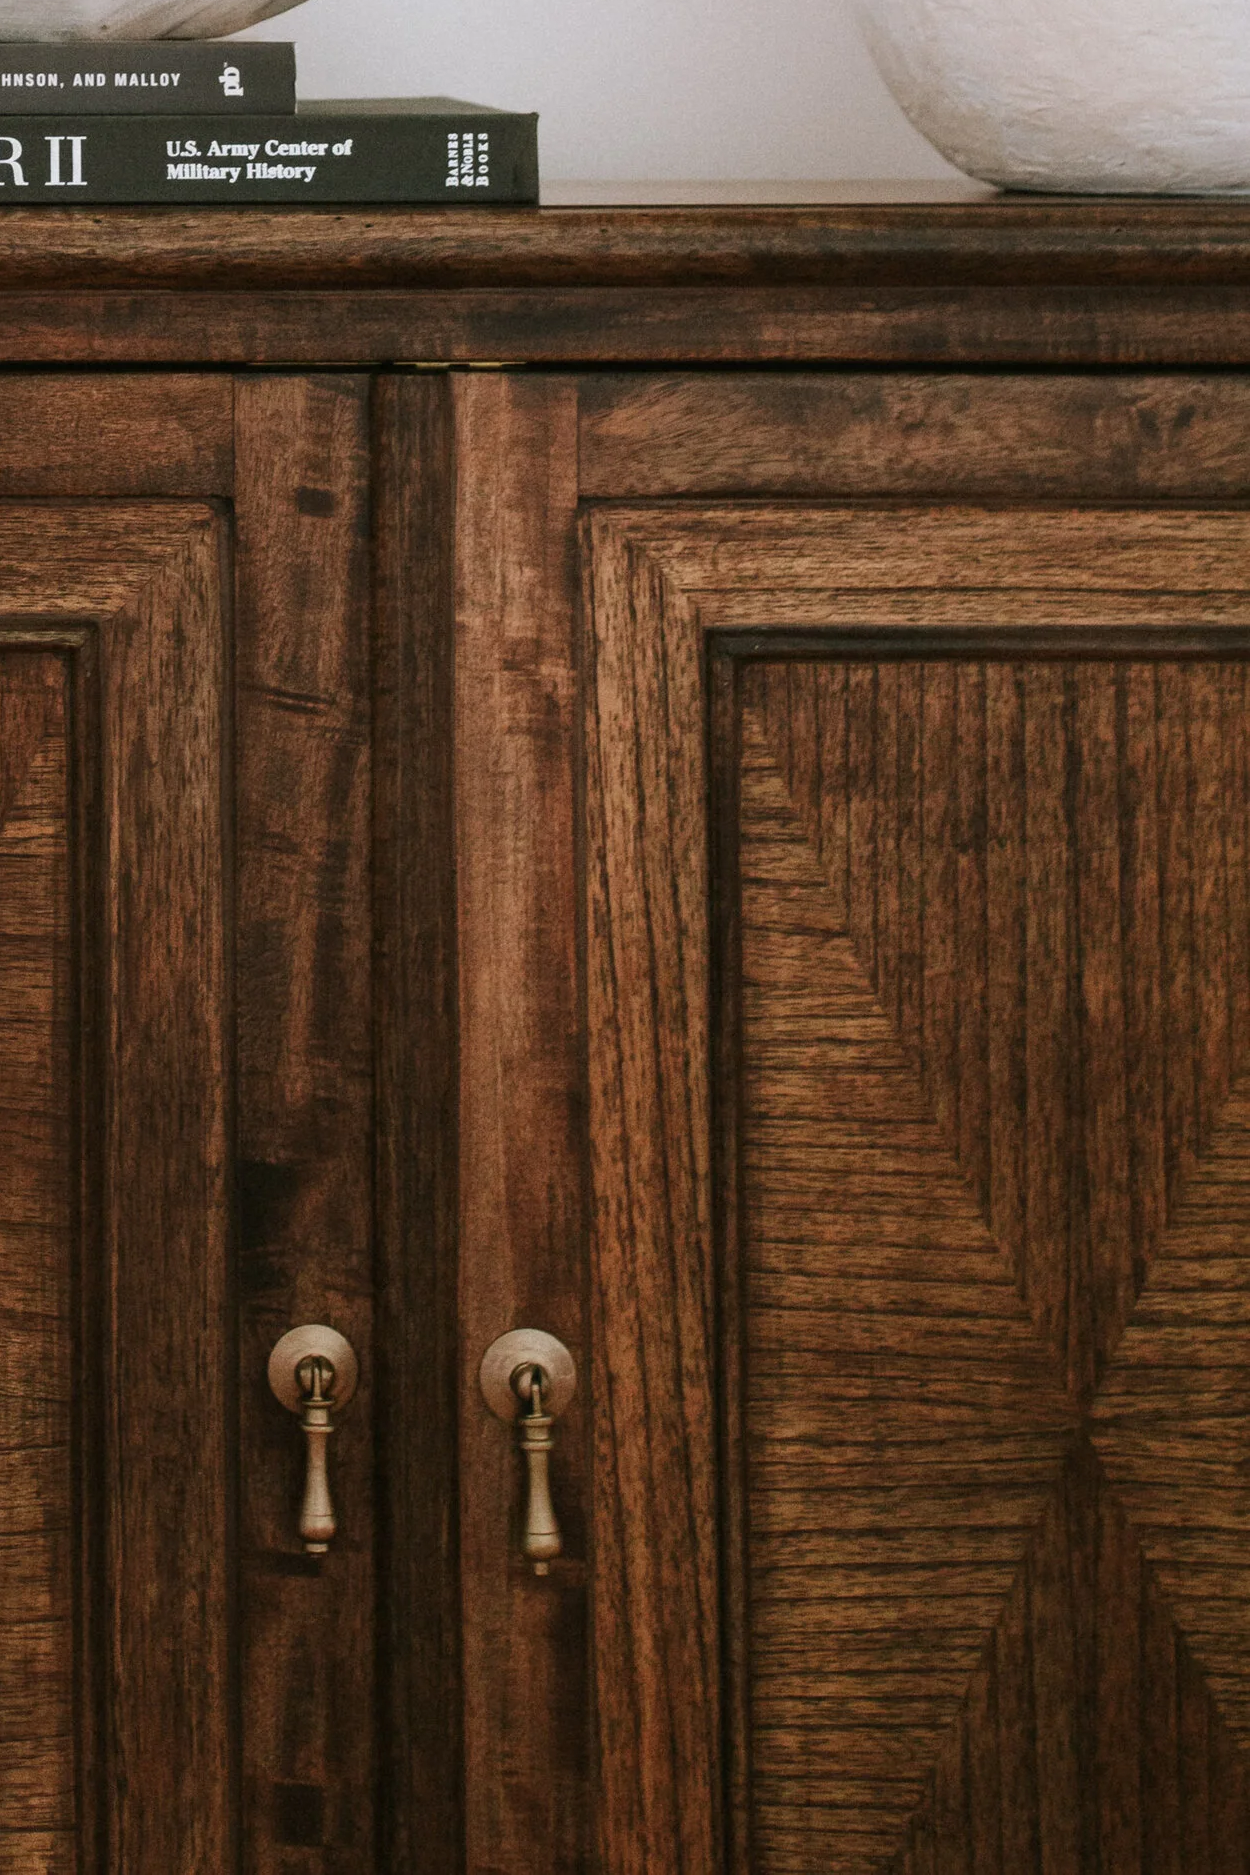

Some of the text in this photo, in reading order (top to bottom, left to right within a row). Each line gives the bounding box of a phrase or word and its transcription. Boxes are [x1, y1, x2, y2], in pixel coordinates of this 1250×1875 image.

[73, 73, 106, 87] AND
[114, 73, 181, 87] MALLOY
[44, 136, 88, 187] II
[166, 139, 354, 160] U.S. Army Center of
[445, 132, 459, 187] BARNES
[475, 132, 489, 187] BOOKS
[166, 162, 318, 184] Military History
